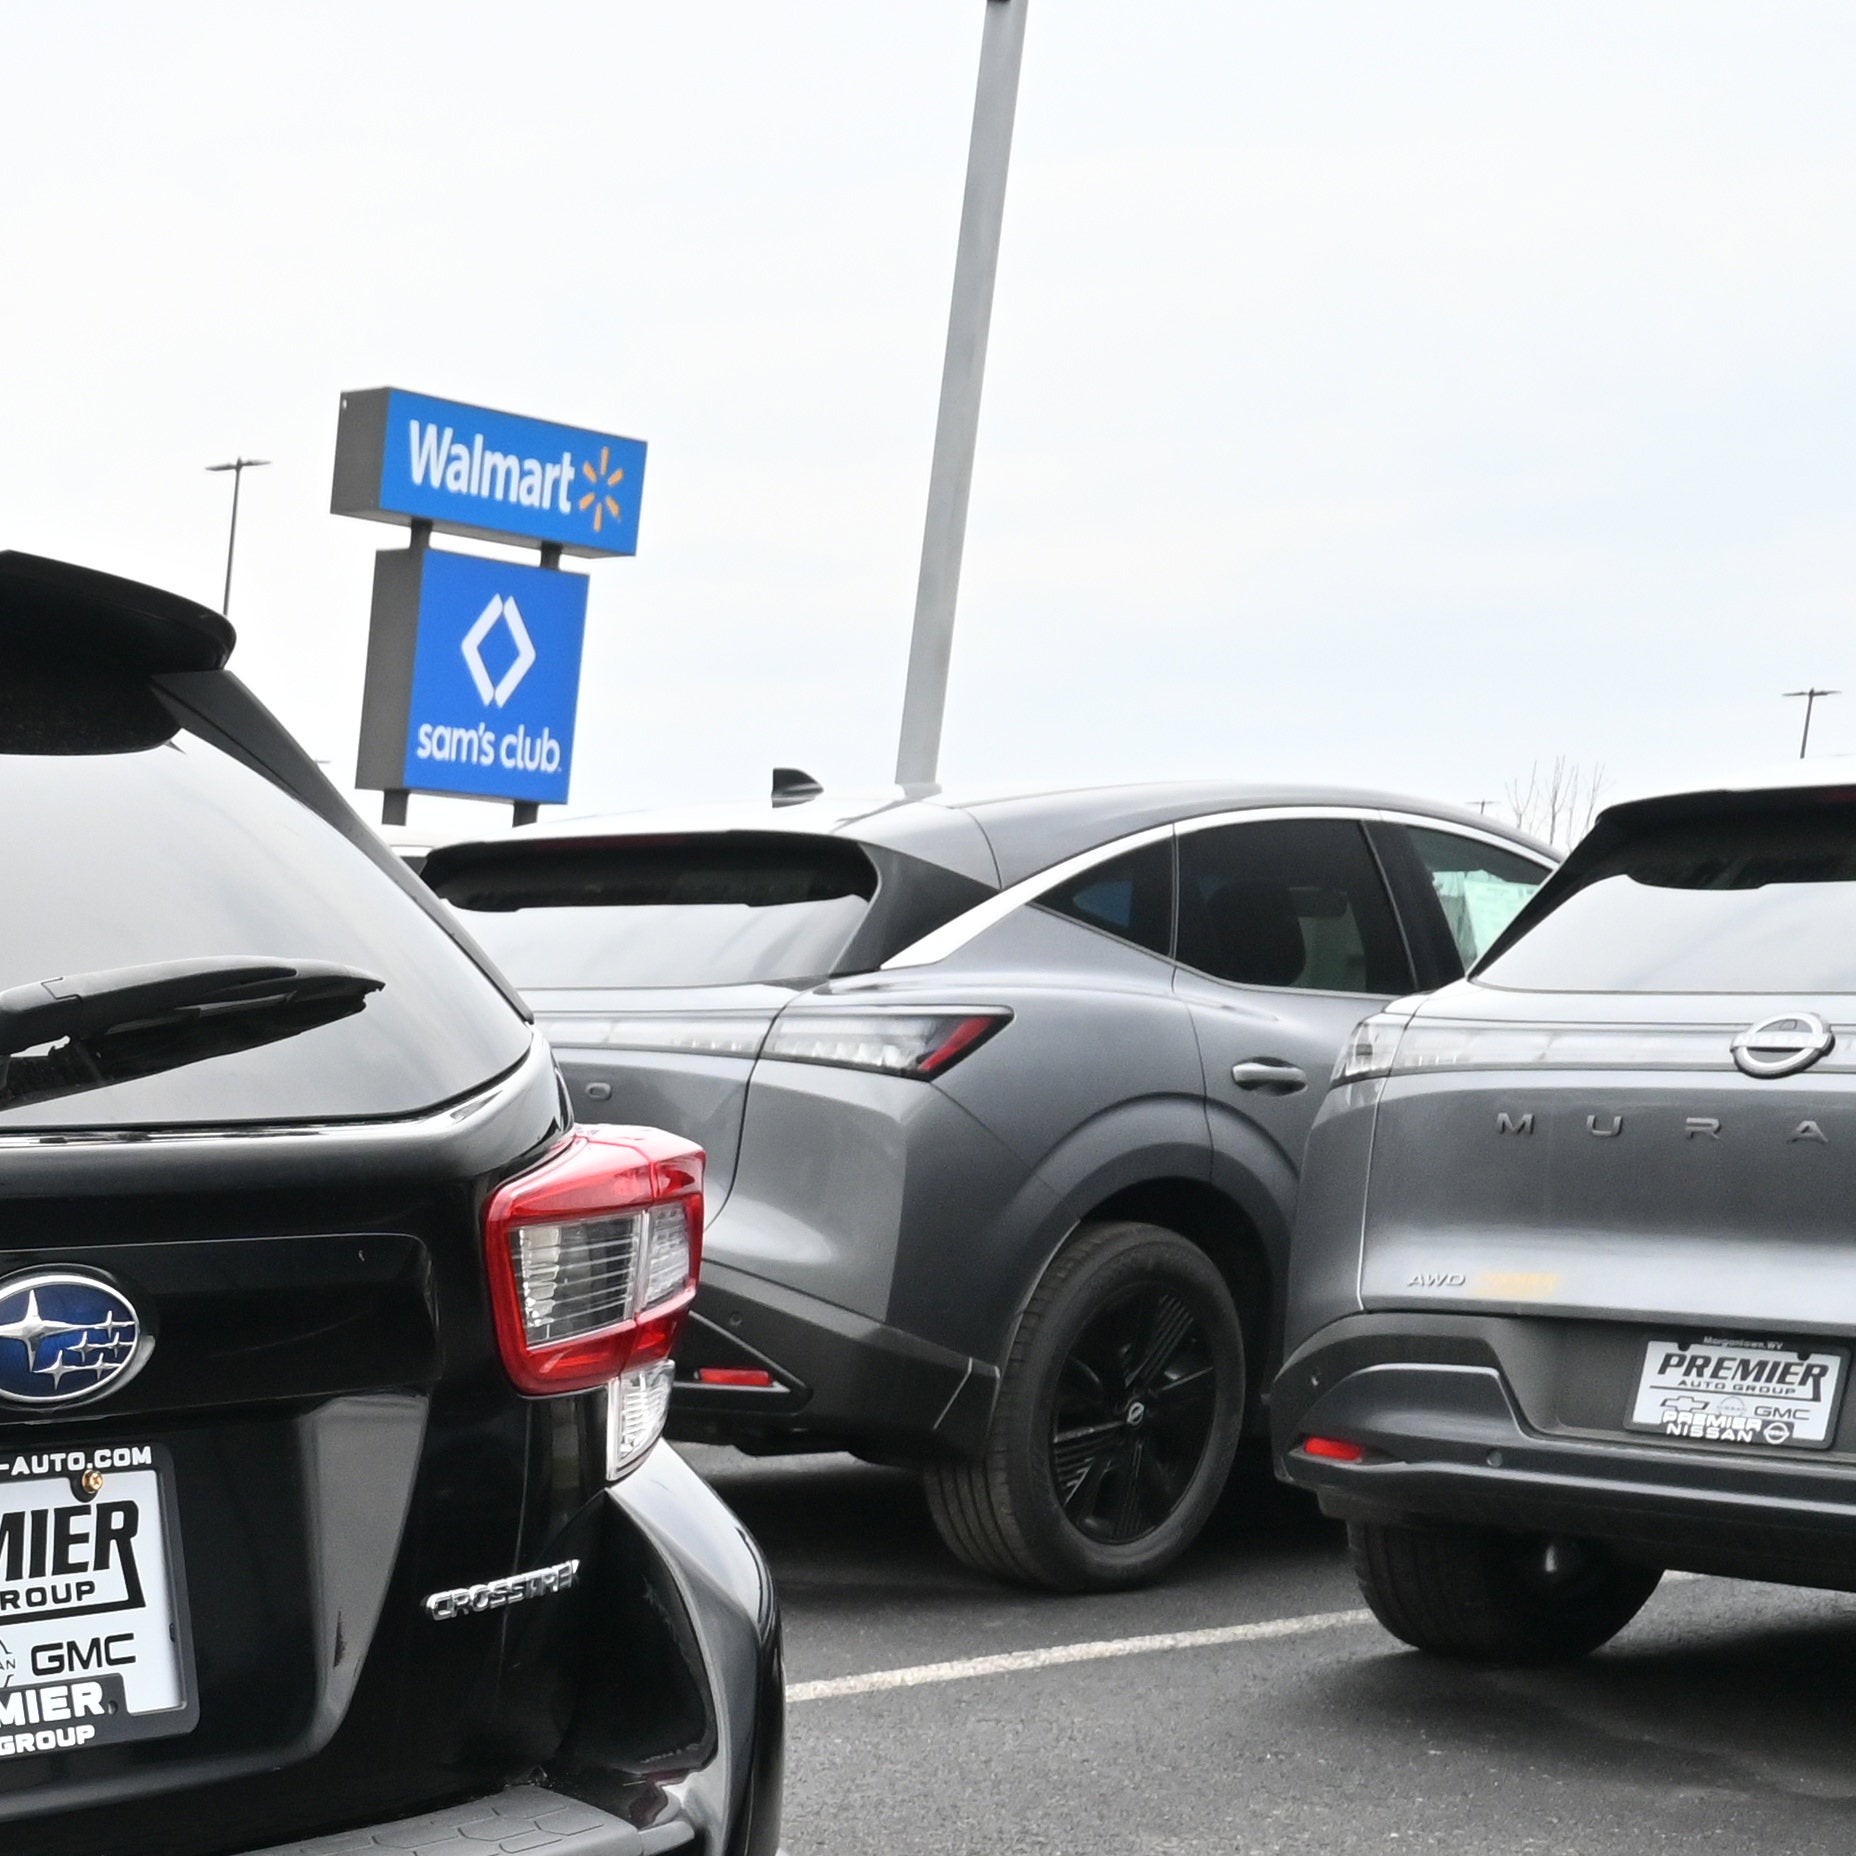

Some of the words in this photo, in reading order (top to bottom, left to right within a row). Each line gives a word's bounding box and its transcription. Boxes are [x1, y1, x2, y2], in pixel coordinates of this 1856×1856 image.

[408, 419, 575, 514] Walmart
[416, 722, 495, 766] sam's
[500, 725, 561, 773] club
[1407, 1273, 1466, 1288] AWD
[1657, 1353, 1829, 1402] PREMIER
[1678, 1379, 1726, 1390] AUTO
[1732, 1383, 1796, 1395] GROUP
[1662, 1411, 1762, 1432] PREMIER
[1754, 1405, 1810, 1420] GMC
[1666, 1423, 1754, 1443] NISSAN
[30, 1632, 138, 1676] GMC
